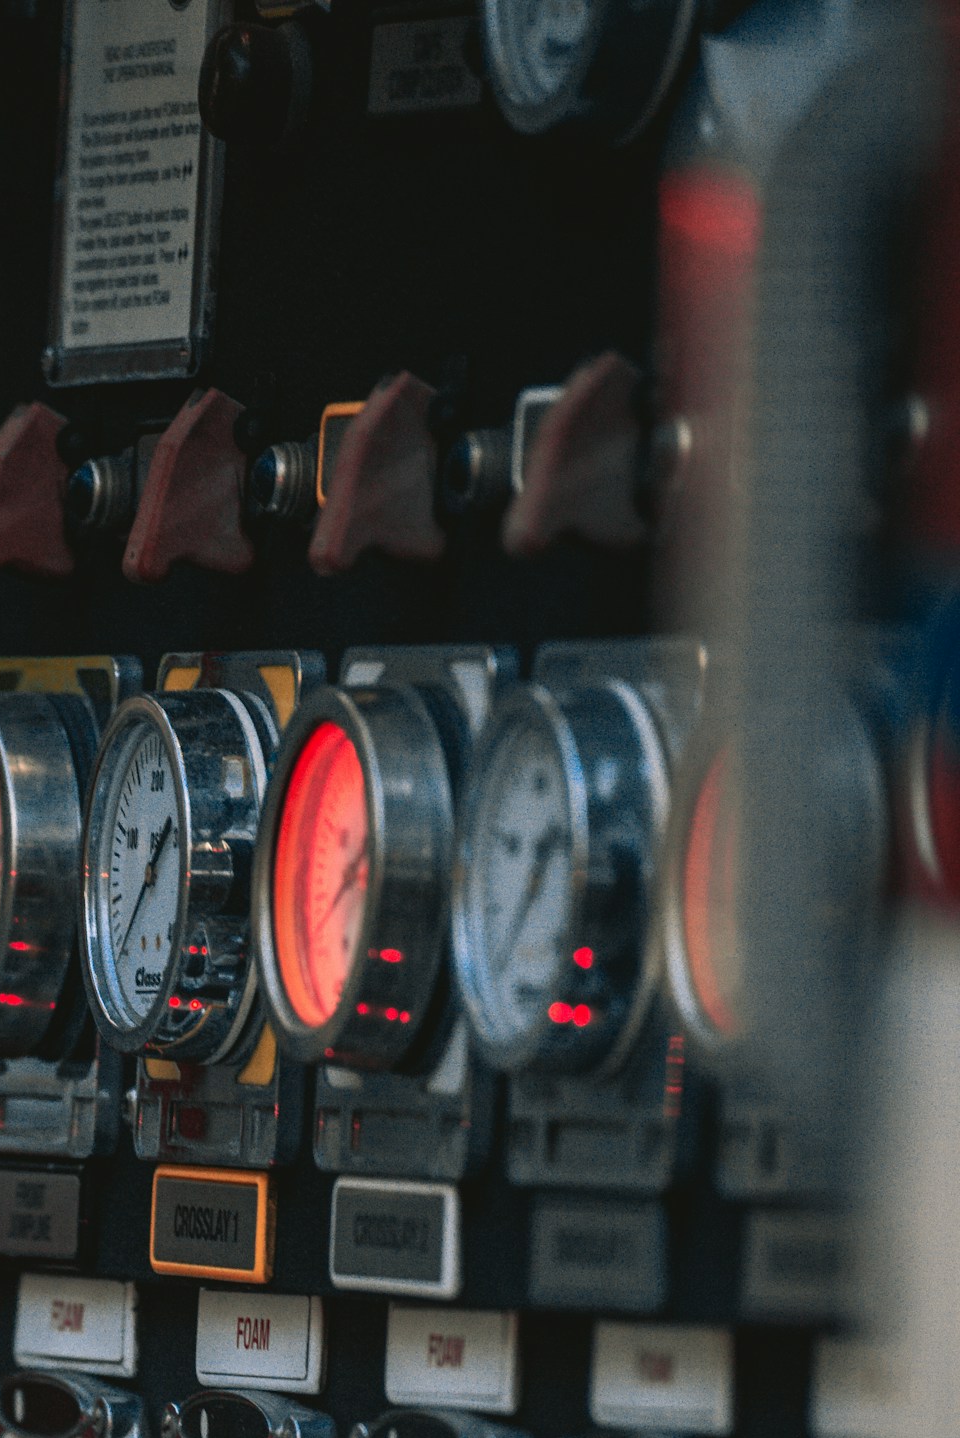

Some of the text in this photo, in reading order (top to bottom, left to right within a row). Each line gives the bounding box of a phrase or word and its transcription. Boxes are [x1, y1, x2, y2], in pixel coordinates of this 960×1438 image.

[151, 770, 165, 792] 200
[173, 1203, 239, 1243] CROSSLAY 1
[51, 1300, 85, 1333] FOAM
[236, 1316, 271, 1350] FOAM
[428, 1333, 465, 1367] FOAM
